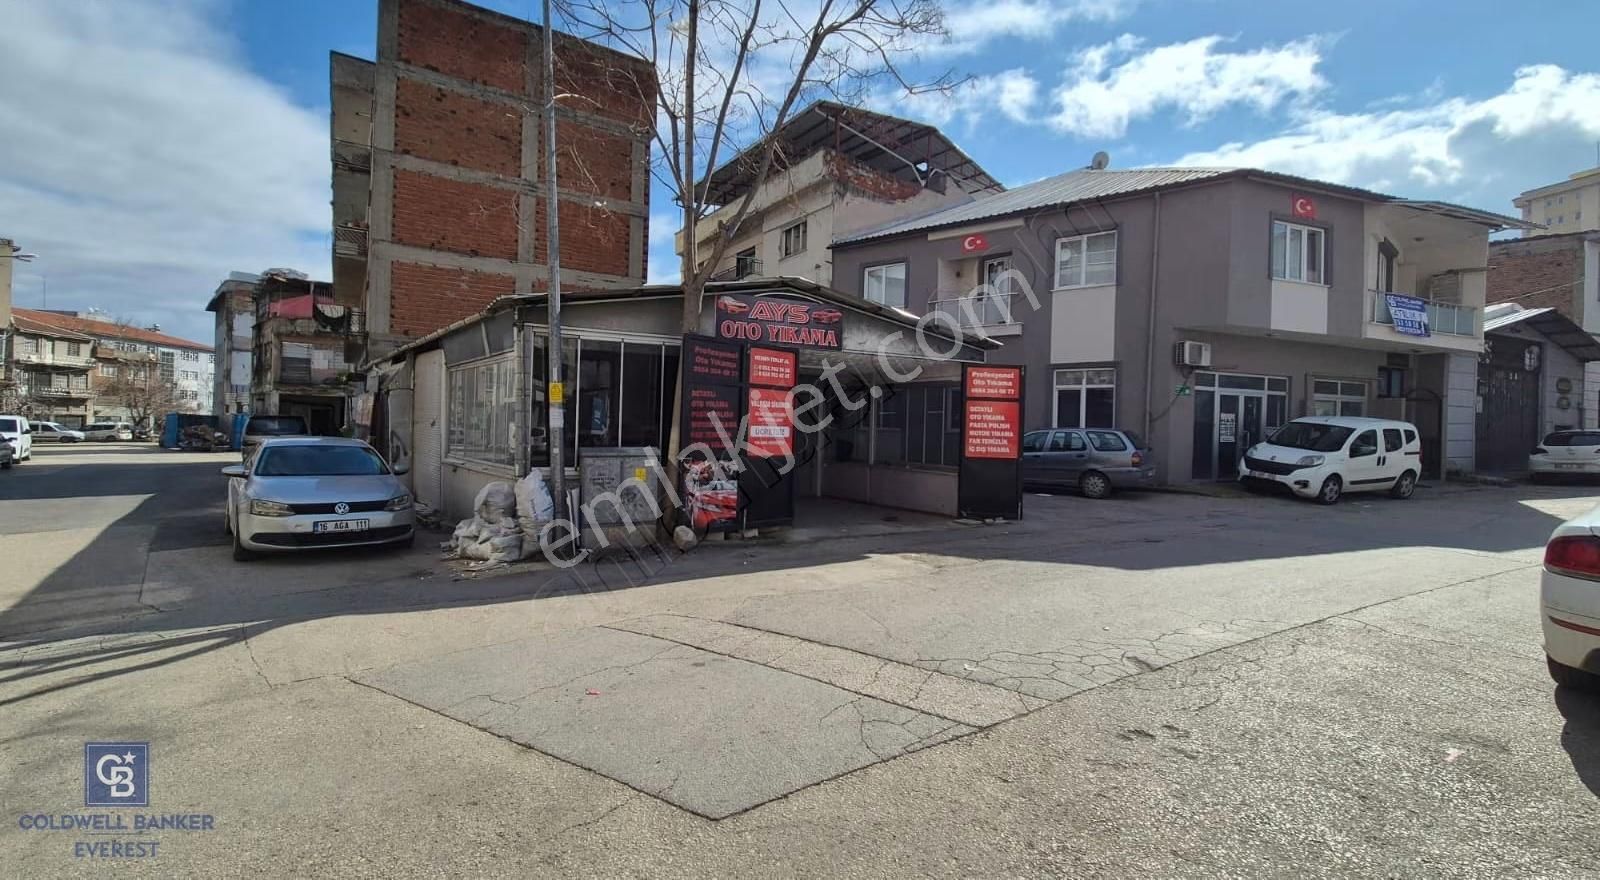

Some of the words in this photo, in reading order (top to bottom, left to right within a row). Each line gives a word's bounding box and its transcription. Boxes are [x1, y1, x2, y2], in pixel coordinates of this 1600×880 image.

[749, 300, 810, 323] AYS
[720, 320, 762, 341] OTO
[767, 325, 838, 347] YIKAMA
[319, 523, 328, 531] 16
[334, 521, 349, 529] AGA
[356, 520, 368, 529] 111
